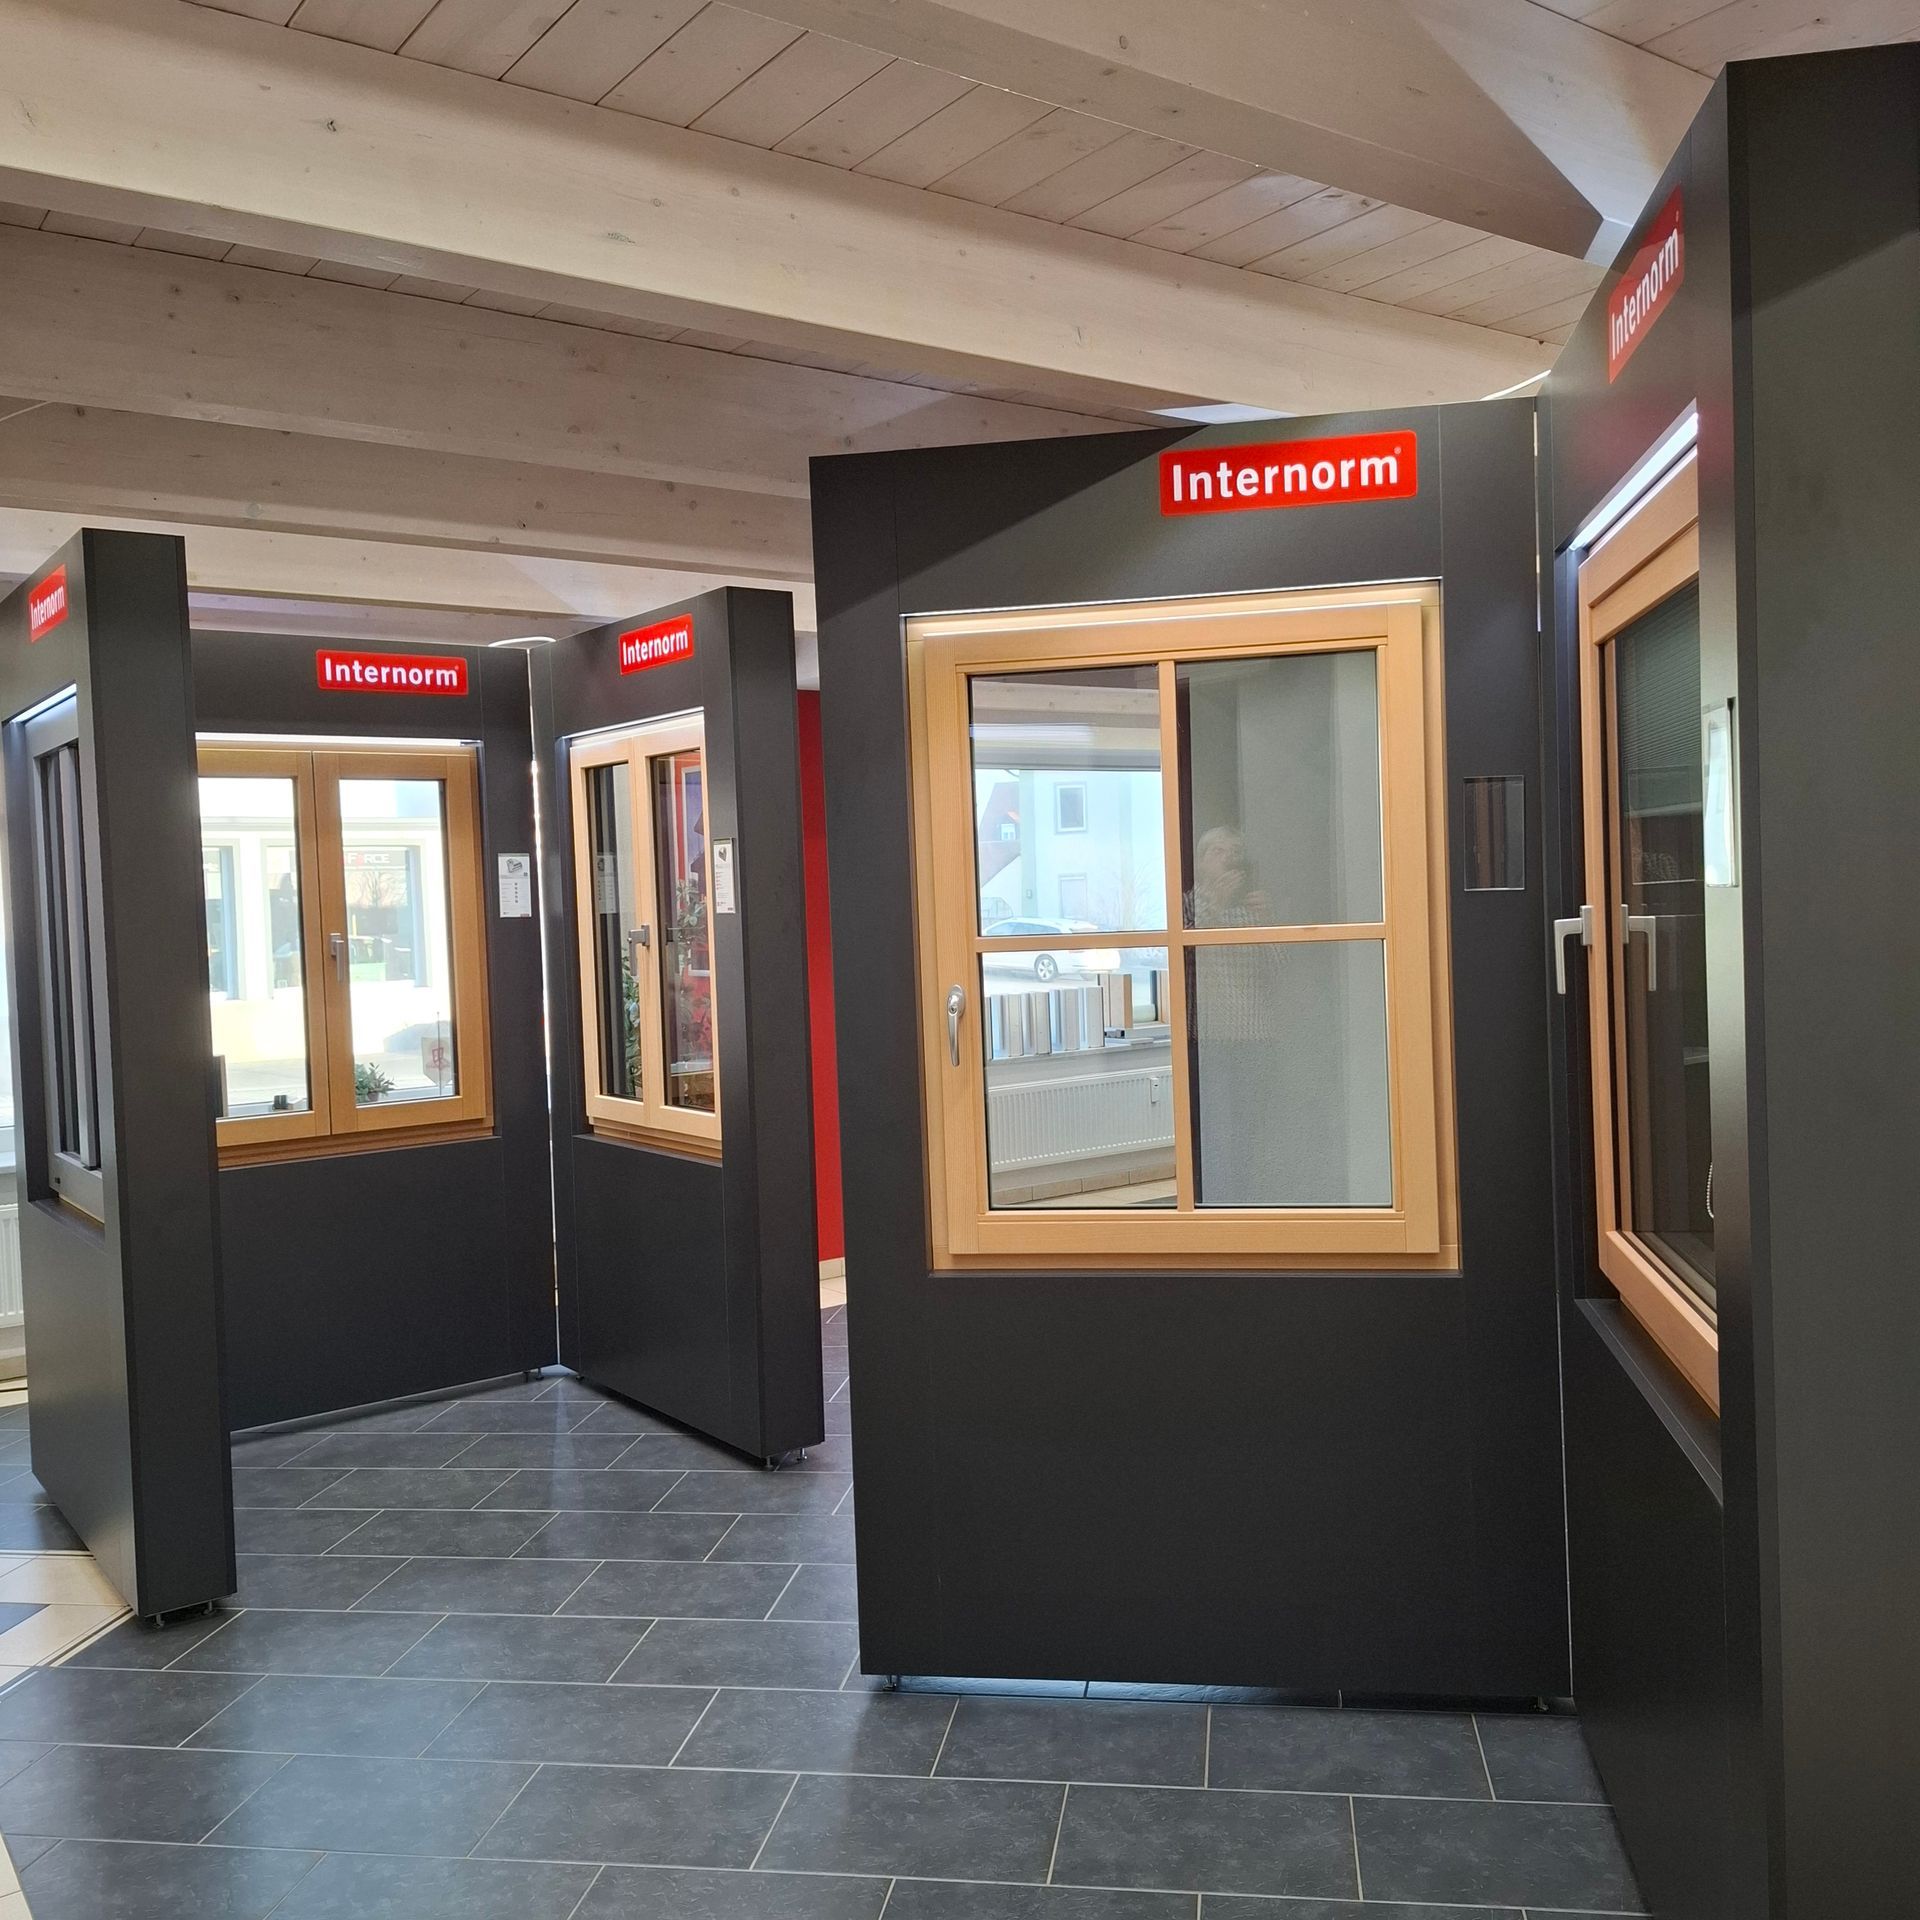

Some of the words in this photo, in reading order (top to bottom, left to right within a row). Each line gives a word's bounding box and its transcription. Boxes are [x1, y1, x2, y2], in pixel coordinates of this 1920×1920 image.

[1611, 228, 1680, 361] Internorm
[1172, 454, 1398, 502] Internorm
[622, 630, 689, 666] Internorm
[324, 658, 458, 686] Internorm
